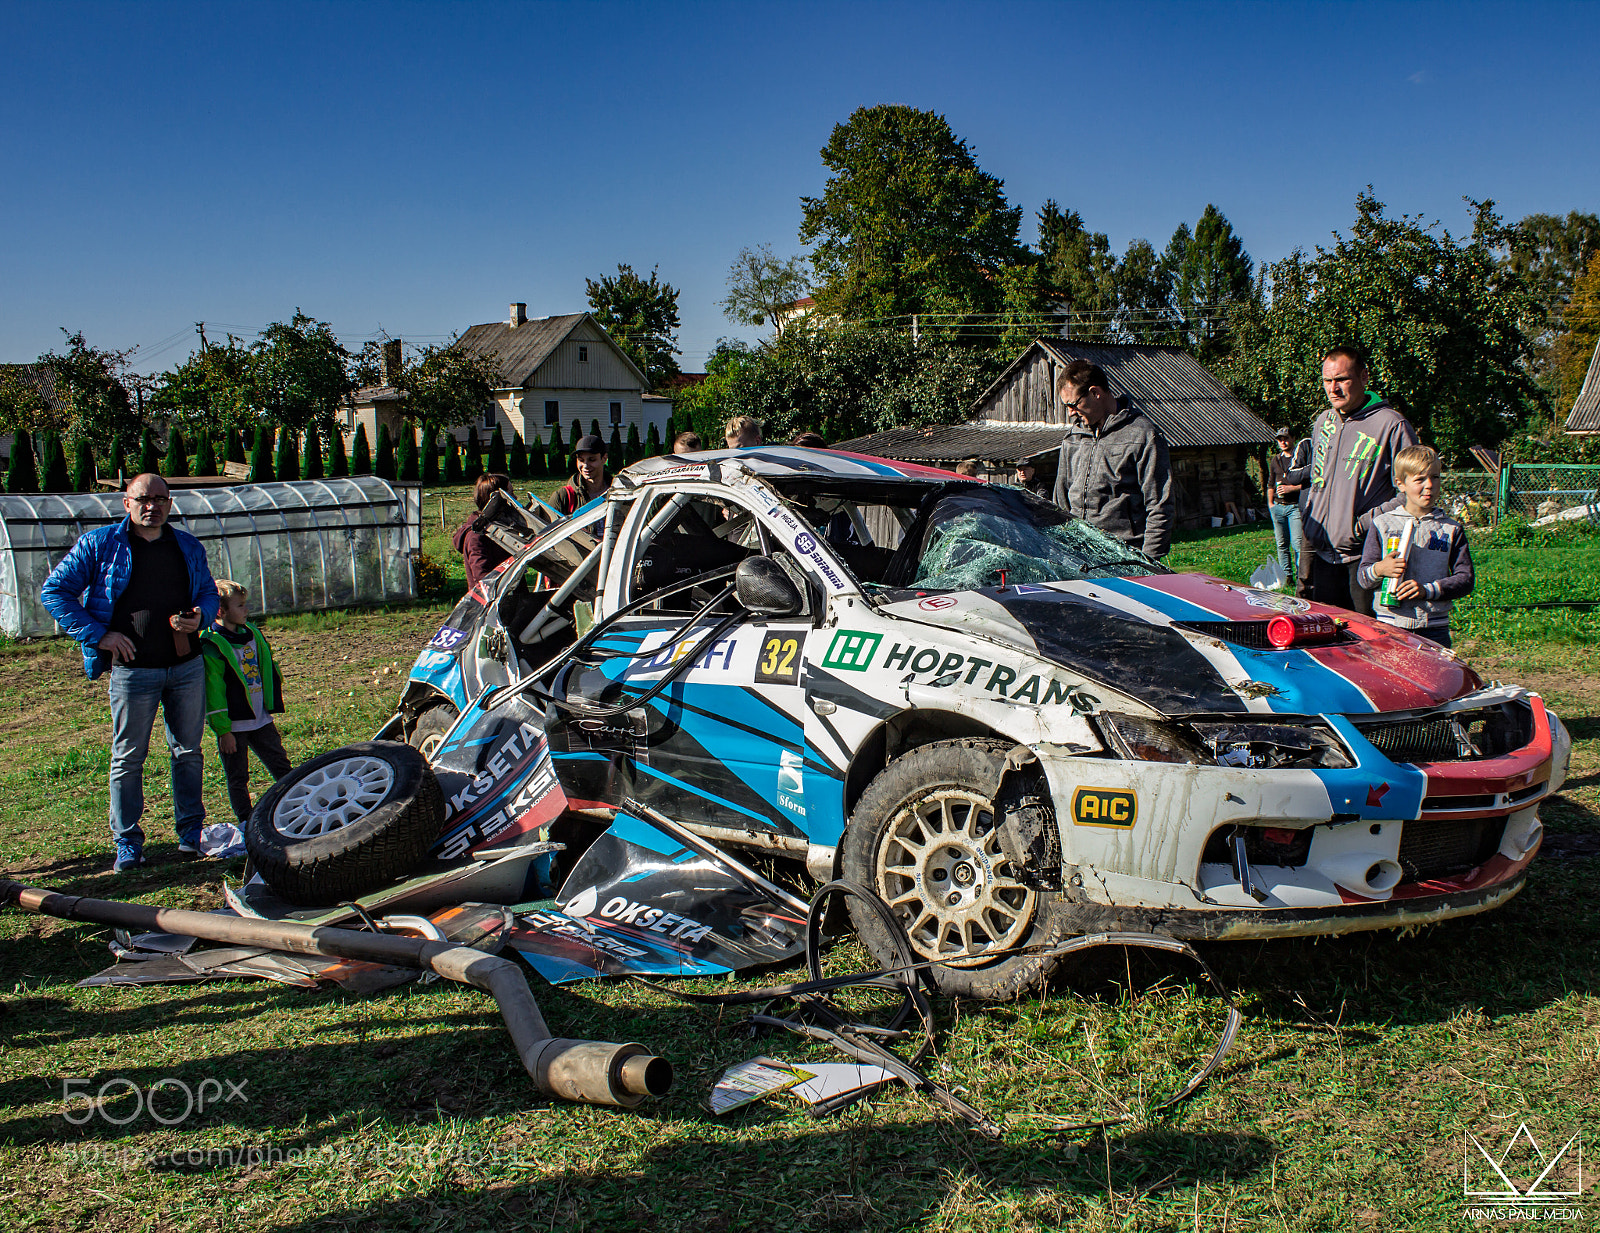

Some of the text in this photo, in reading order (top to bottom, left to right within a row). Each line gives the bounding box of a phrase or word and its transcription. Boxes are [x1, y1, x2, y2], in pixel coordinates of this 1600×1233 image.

[761, 638, 799, 676] 32
[882, 642, 1102, 712] HOPTRANS
[779, 795, 806, 817] Sform
[1080, 795, 1130, 821] AIC
[600, 896, 713, 943] OKSETA
